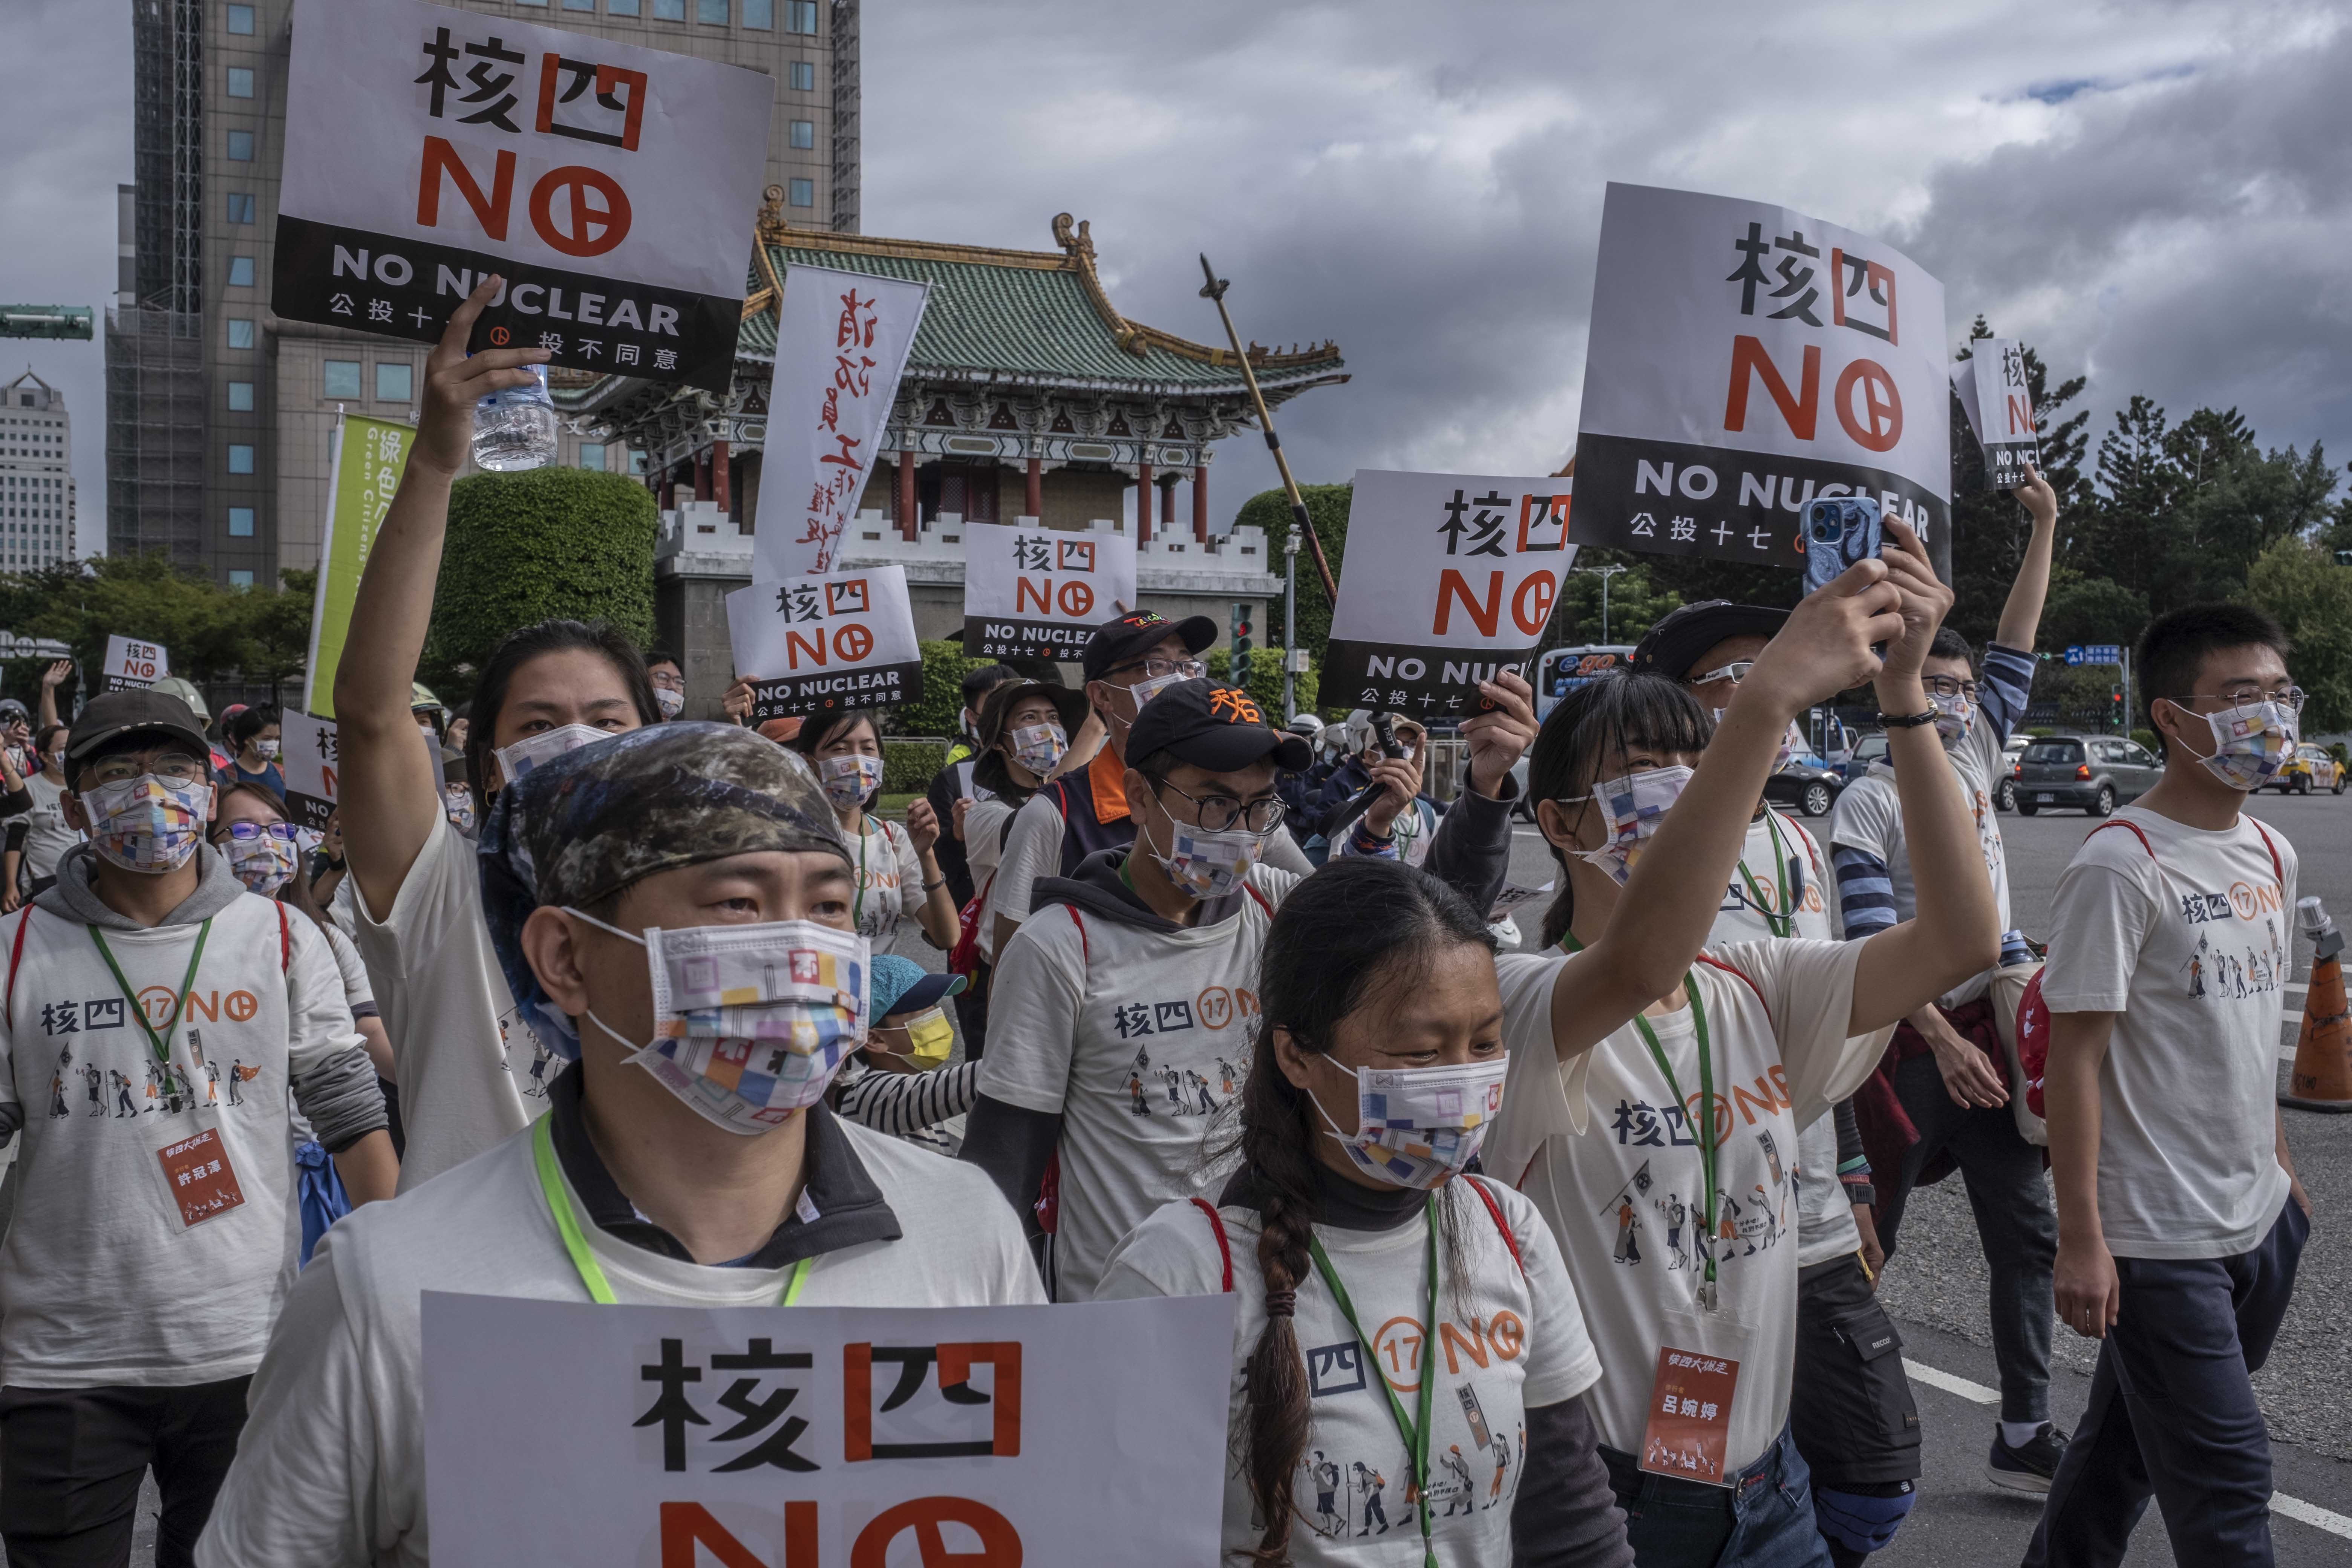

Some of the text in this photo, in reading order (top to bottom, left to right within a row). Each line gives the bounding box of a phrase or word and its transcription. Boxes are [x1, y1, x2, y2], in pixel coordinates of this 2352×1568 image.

[413, 27, 648, 152] 核四
[417, 135, 632, 257] NO
[332, 245, 413, 286] NO
[1725, 222, 1898, 346] 核四
[330, 293, 452, 330] 公投十
[1723, 335, 1903, 452] NO
[364, 427, 378, 480] Green
[1997, 451, 2012, 466] NO
[1635, 459, 1718, 499] NO
[1436, 489, 1571, 557] 核四
[1631, 512, 1771, 550] 公投十七
[1013, 534, 1095, 573] 核四
[776, 579, 870, 624] 核四
[1016, 576, 1094, 617] NO
[1433, 569, 1556, 637] NO
[786, 623, 874, 670] NO
[983, 644, 1035, 657] 公投十七
[985, 625, 1015, 639] NO
[124, 659, 155, 678] NO
[126, 642, 156, 661] 核四
[1366, 655, 1426, 680] NO
[758, 671, 900, 701] NO NUCLEAR
[758, 690, 902, 717] 公投十七 投不同意
[1361, 688, 1463, 709] 公投十七
[1383, 727, 1396, 747] LEKI
[305, 800, 329, 818] NO
[2182, 893, 2232, 924] 核四
[41, 998, 125, 1036] 核四
[186, 991, 258, 1023] NO
[1114, 1000, 1194, 1039] 核四
[178, 1159, 222, 1187] 許冠澤
[1439, 1310, 1524, 1374] NO
[1872, 1338, 1890, 1349] RECCO
[631, 1337, 1022, 1473] 核四
[1663, 1394, 1718, 1421] 呂婉婷
